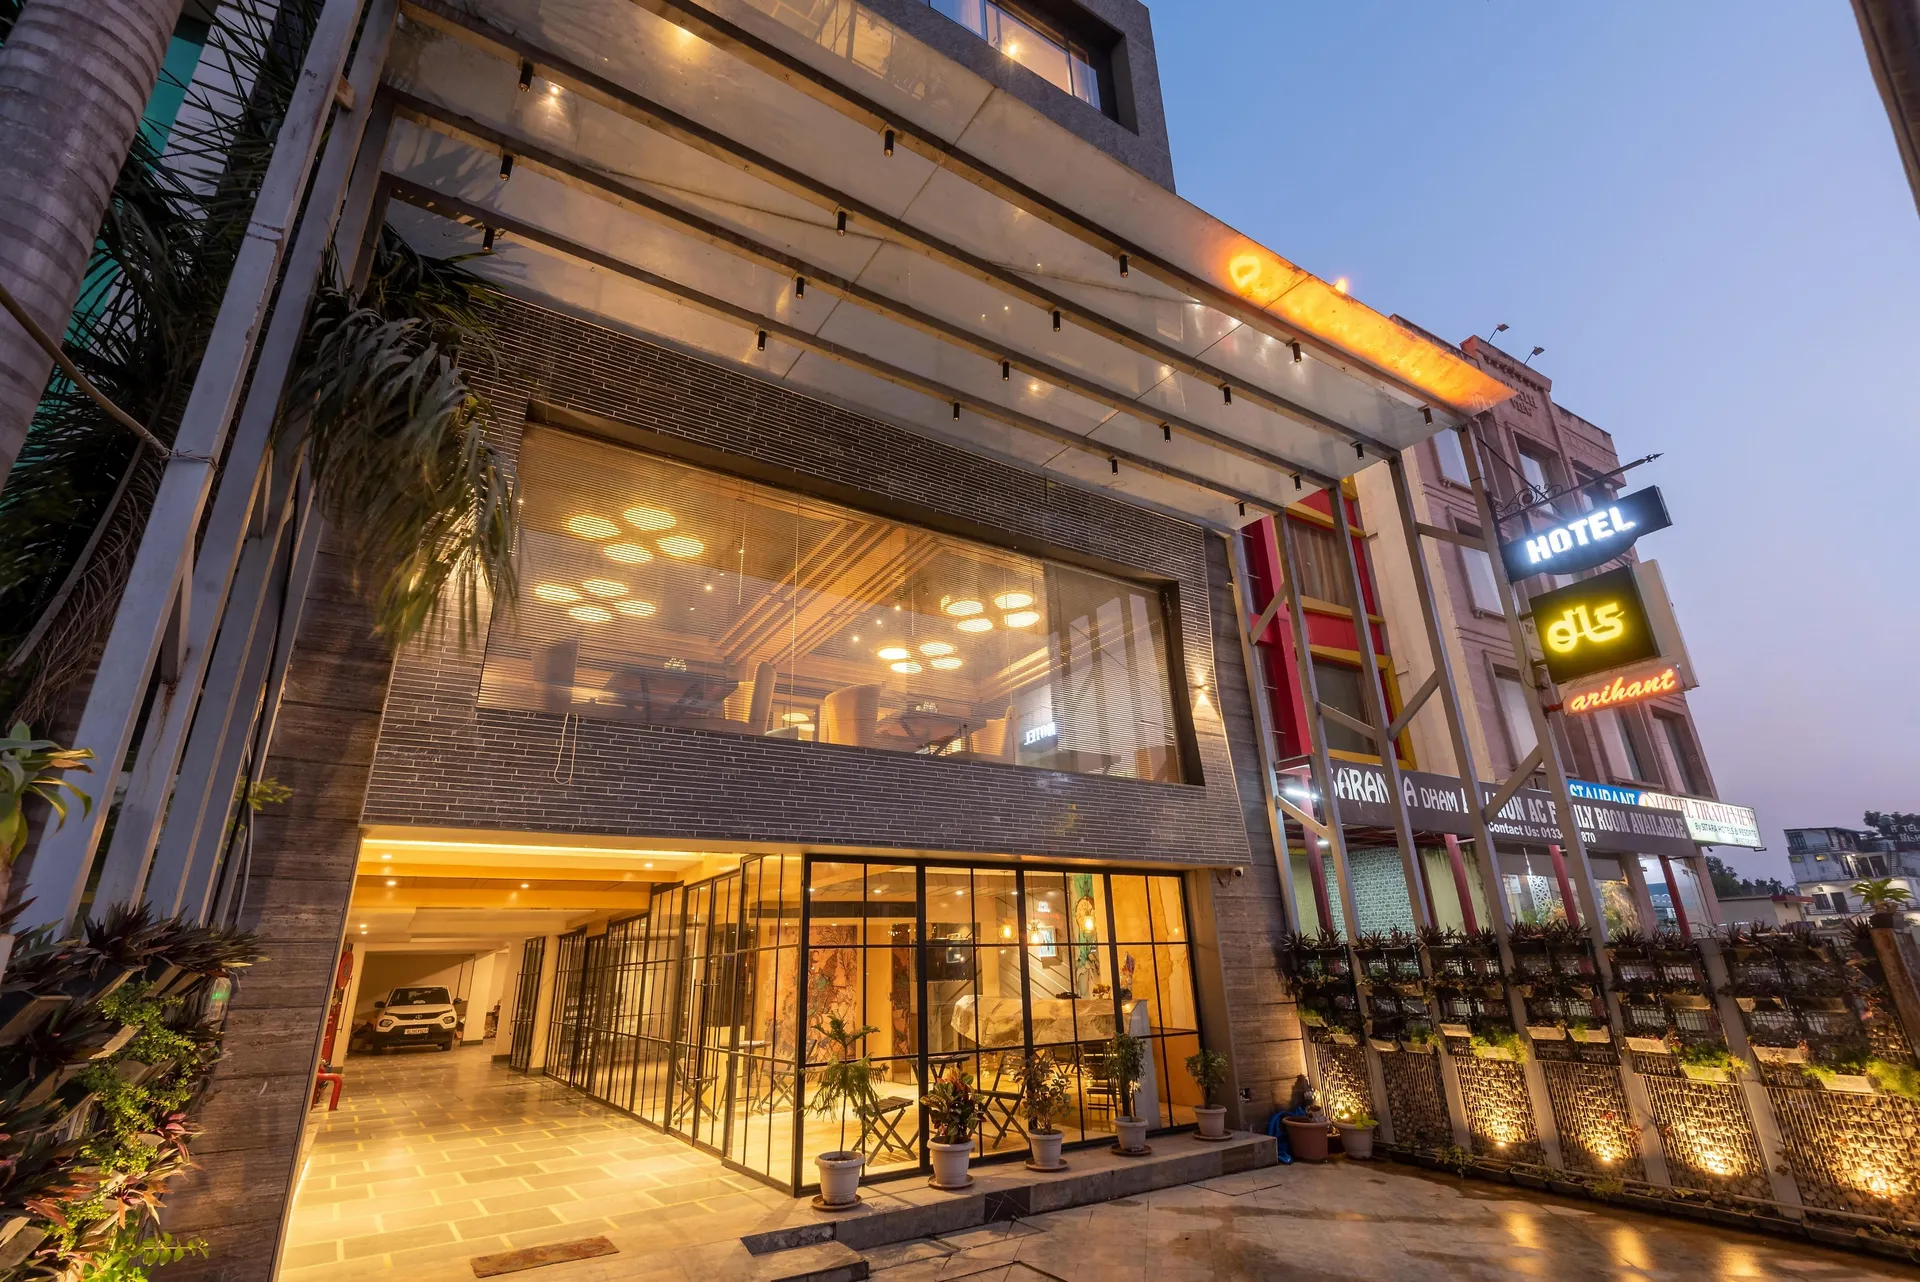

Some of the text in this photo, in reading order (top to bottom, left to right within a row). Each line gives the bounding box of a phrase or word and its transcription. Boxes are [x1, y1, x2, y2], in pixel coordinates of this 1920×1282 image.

[1526, 506, 1636, 565] HOTEL
[1570, 668, 1676, 711] arihant
[1420, 787, 1459, 813] DHAM
[1527, 798, 1547, 824] AC
[1594, 807, 1630, 833] ROOM
[1629, 812, 1688, 839] AVAILABLE
[1488, 821, 1524, 836] Contact
[1524, 825, 1540, 837] Us:
